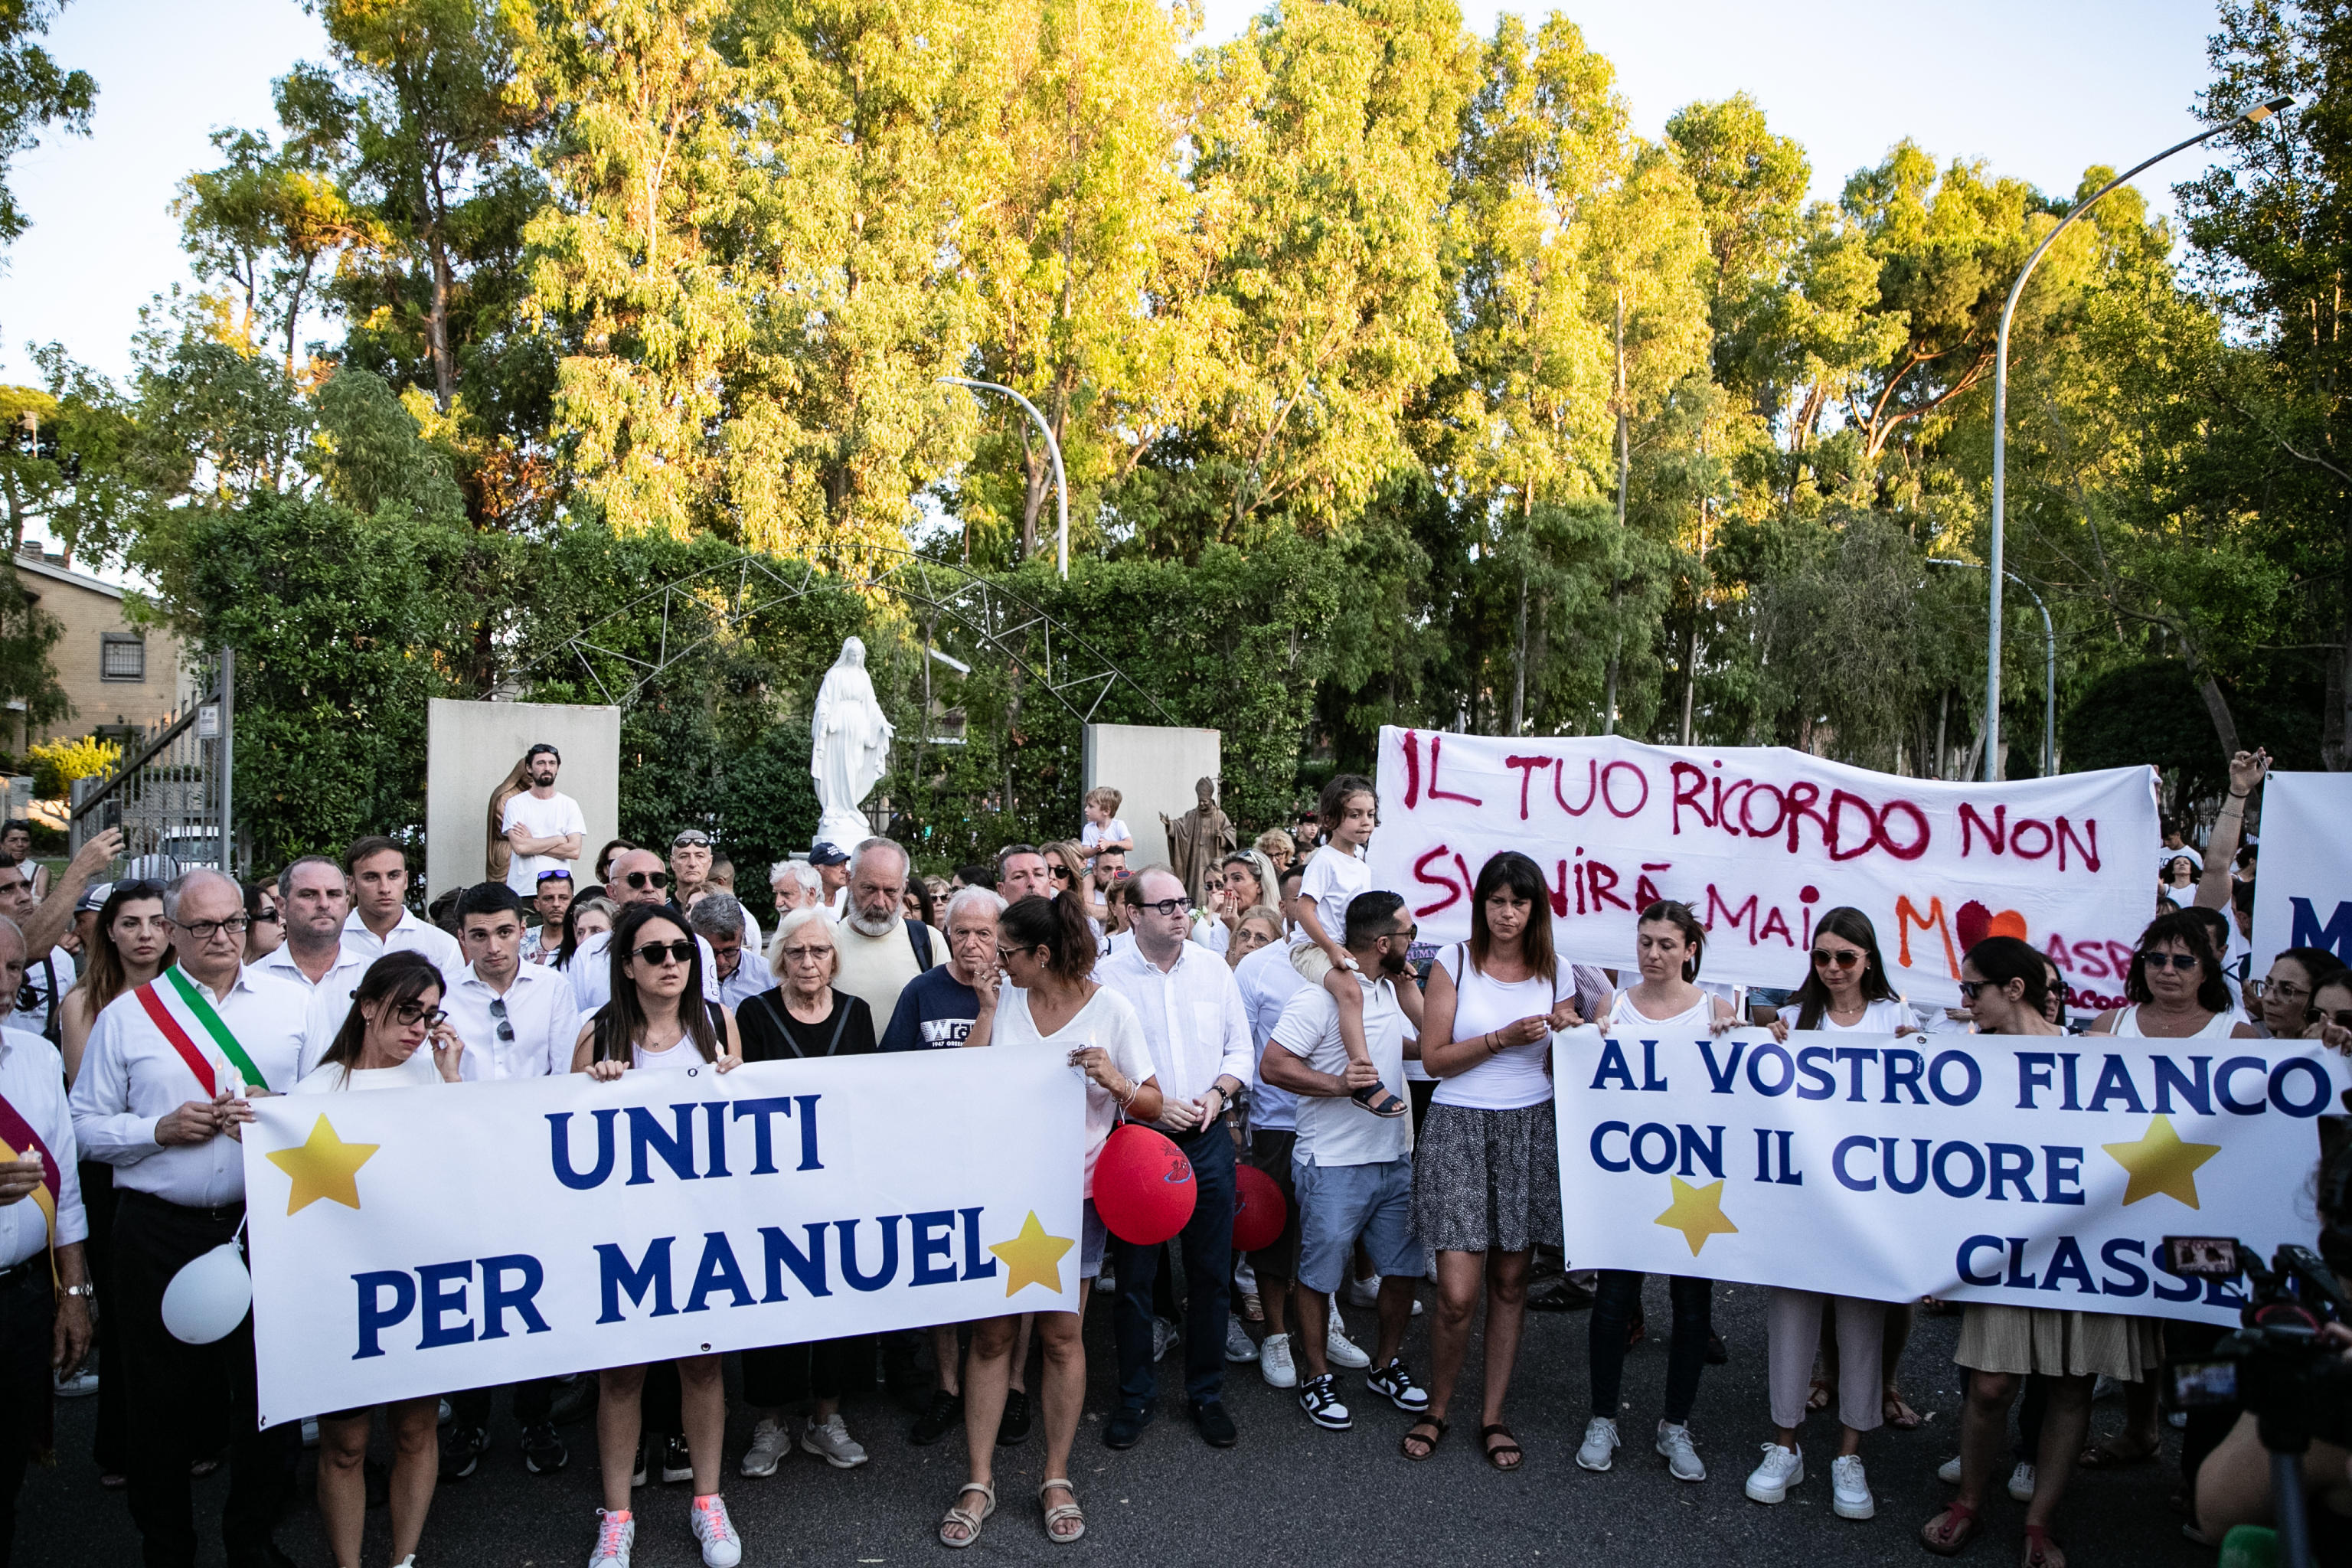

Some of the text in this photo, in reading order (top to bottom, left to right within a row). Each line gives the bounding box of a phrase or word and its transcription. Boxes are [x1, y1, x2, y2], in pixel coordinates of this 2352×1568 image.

[1402, 728, 1483, 811] IL
[1504, 755, 1649, 821] TUO
[1957, 802, 2100, 873] NON
[1589, 1039, 2332, 1119] AL VOSTRO FIANCO
[545, 1094, 825, 1191] UNITI
[1590, 1120, 2086, 1206] CON IL CUORE
[350, 1207, 998, 1361] PER MANUEL
